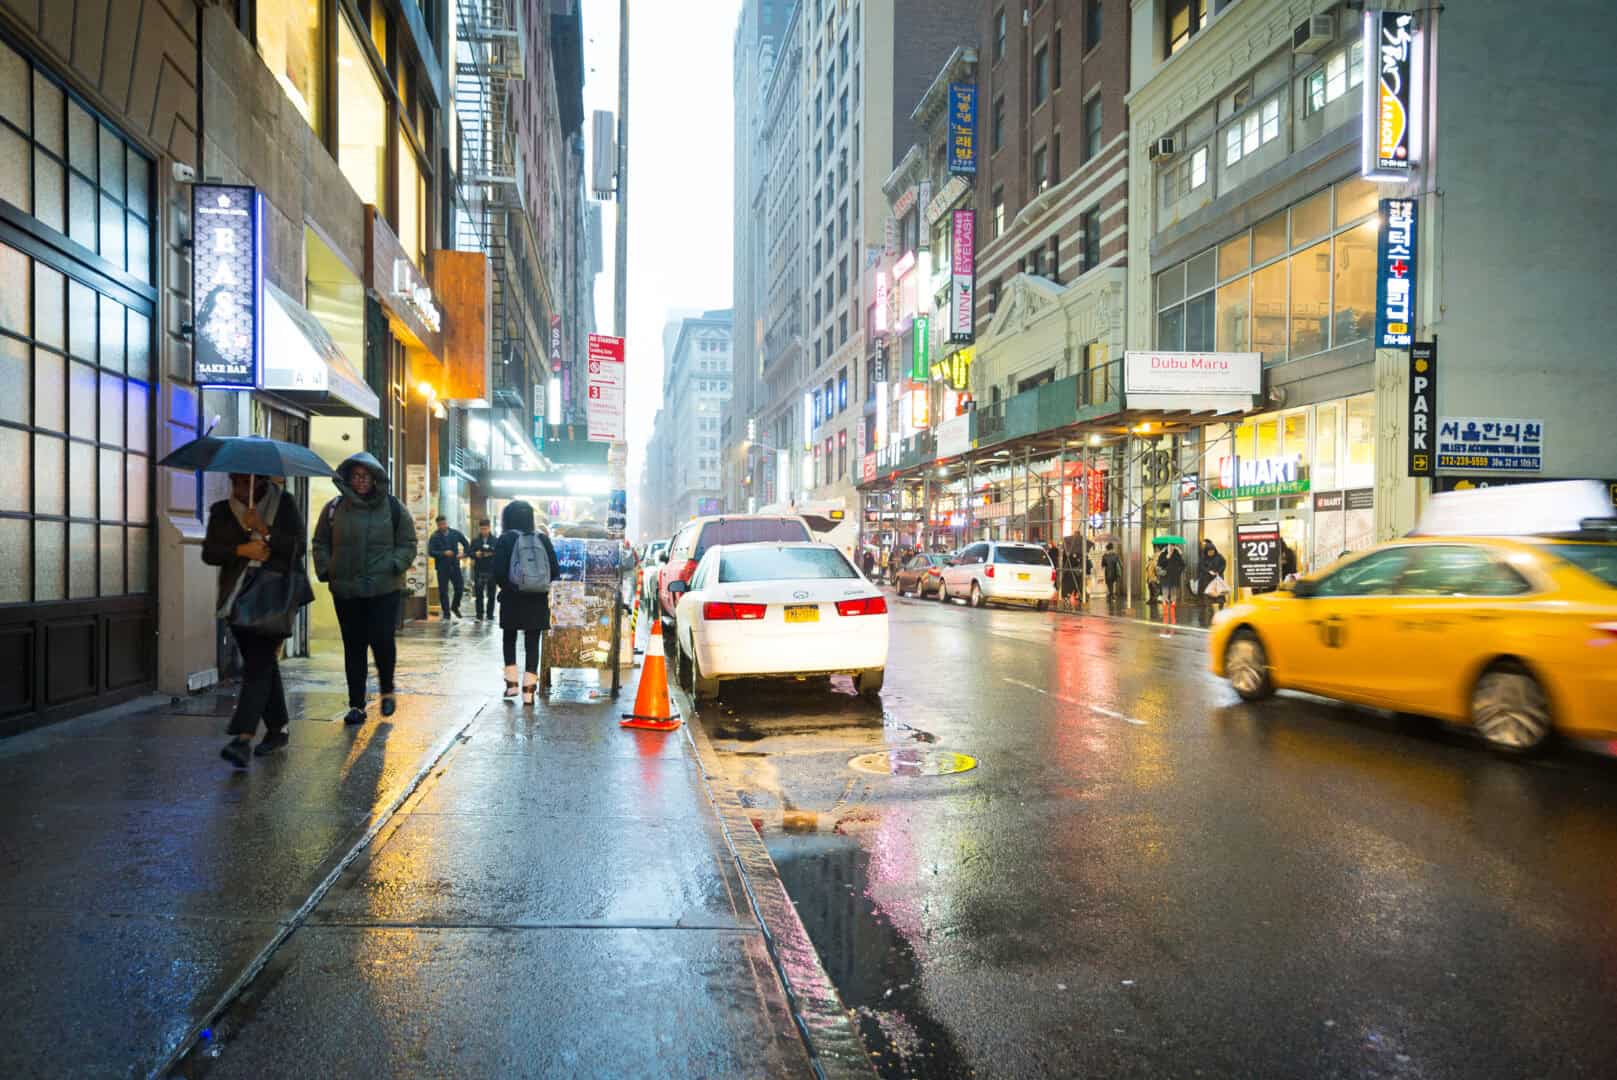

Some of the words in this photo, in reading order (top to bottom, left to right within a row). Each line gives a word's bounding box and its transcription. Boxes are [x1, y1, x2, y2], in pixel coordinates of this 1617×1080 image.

[552, 327, 560, 358] SPA
[227, 364, 248, 375] BAR
[1151, 357, 1188, 369] Dubu
[1191, 358, 1228, 370] Maru
[1414, 376, 1428, 450] PARK
[1239, 456, 1298, 487] MART
